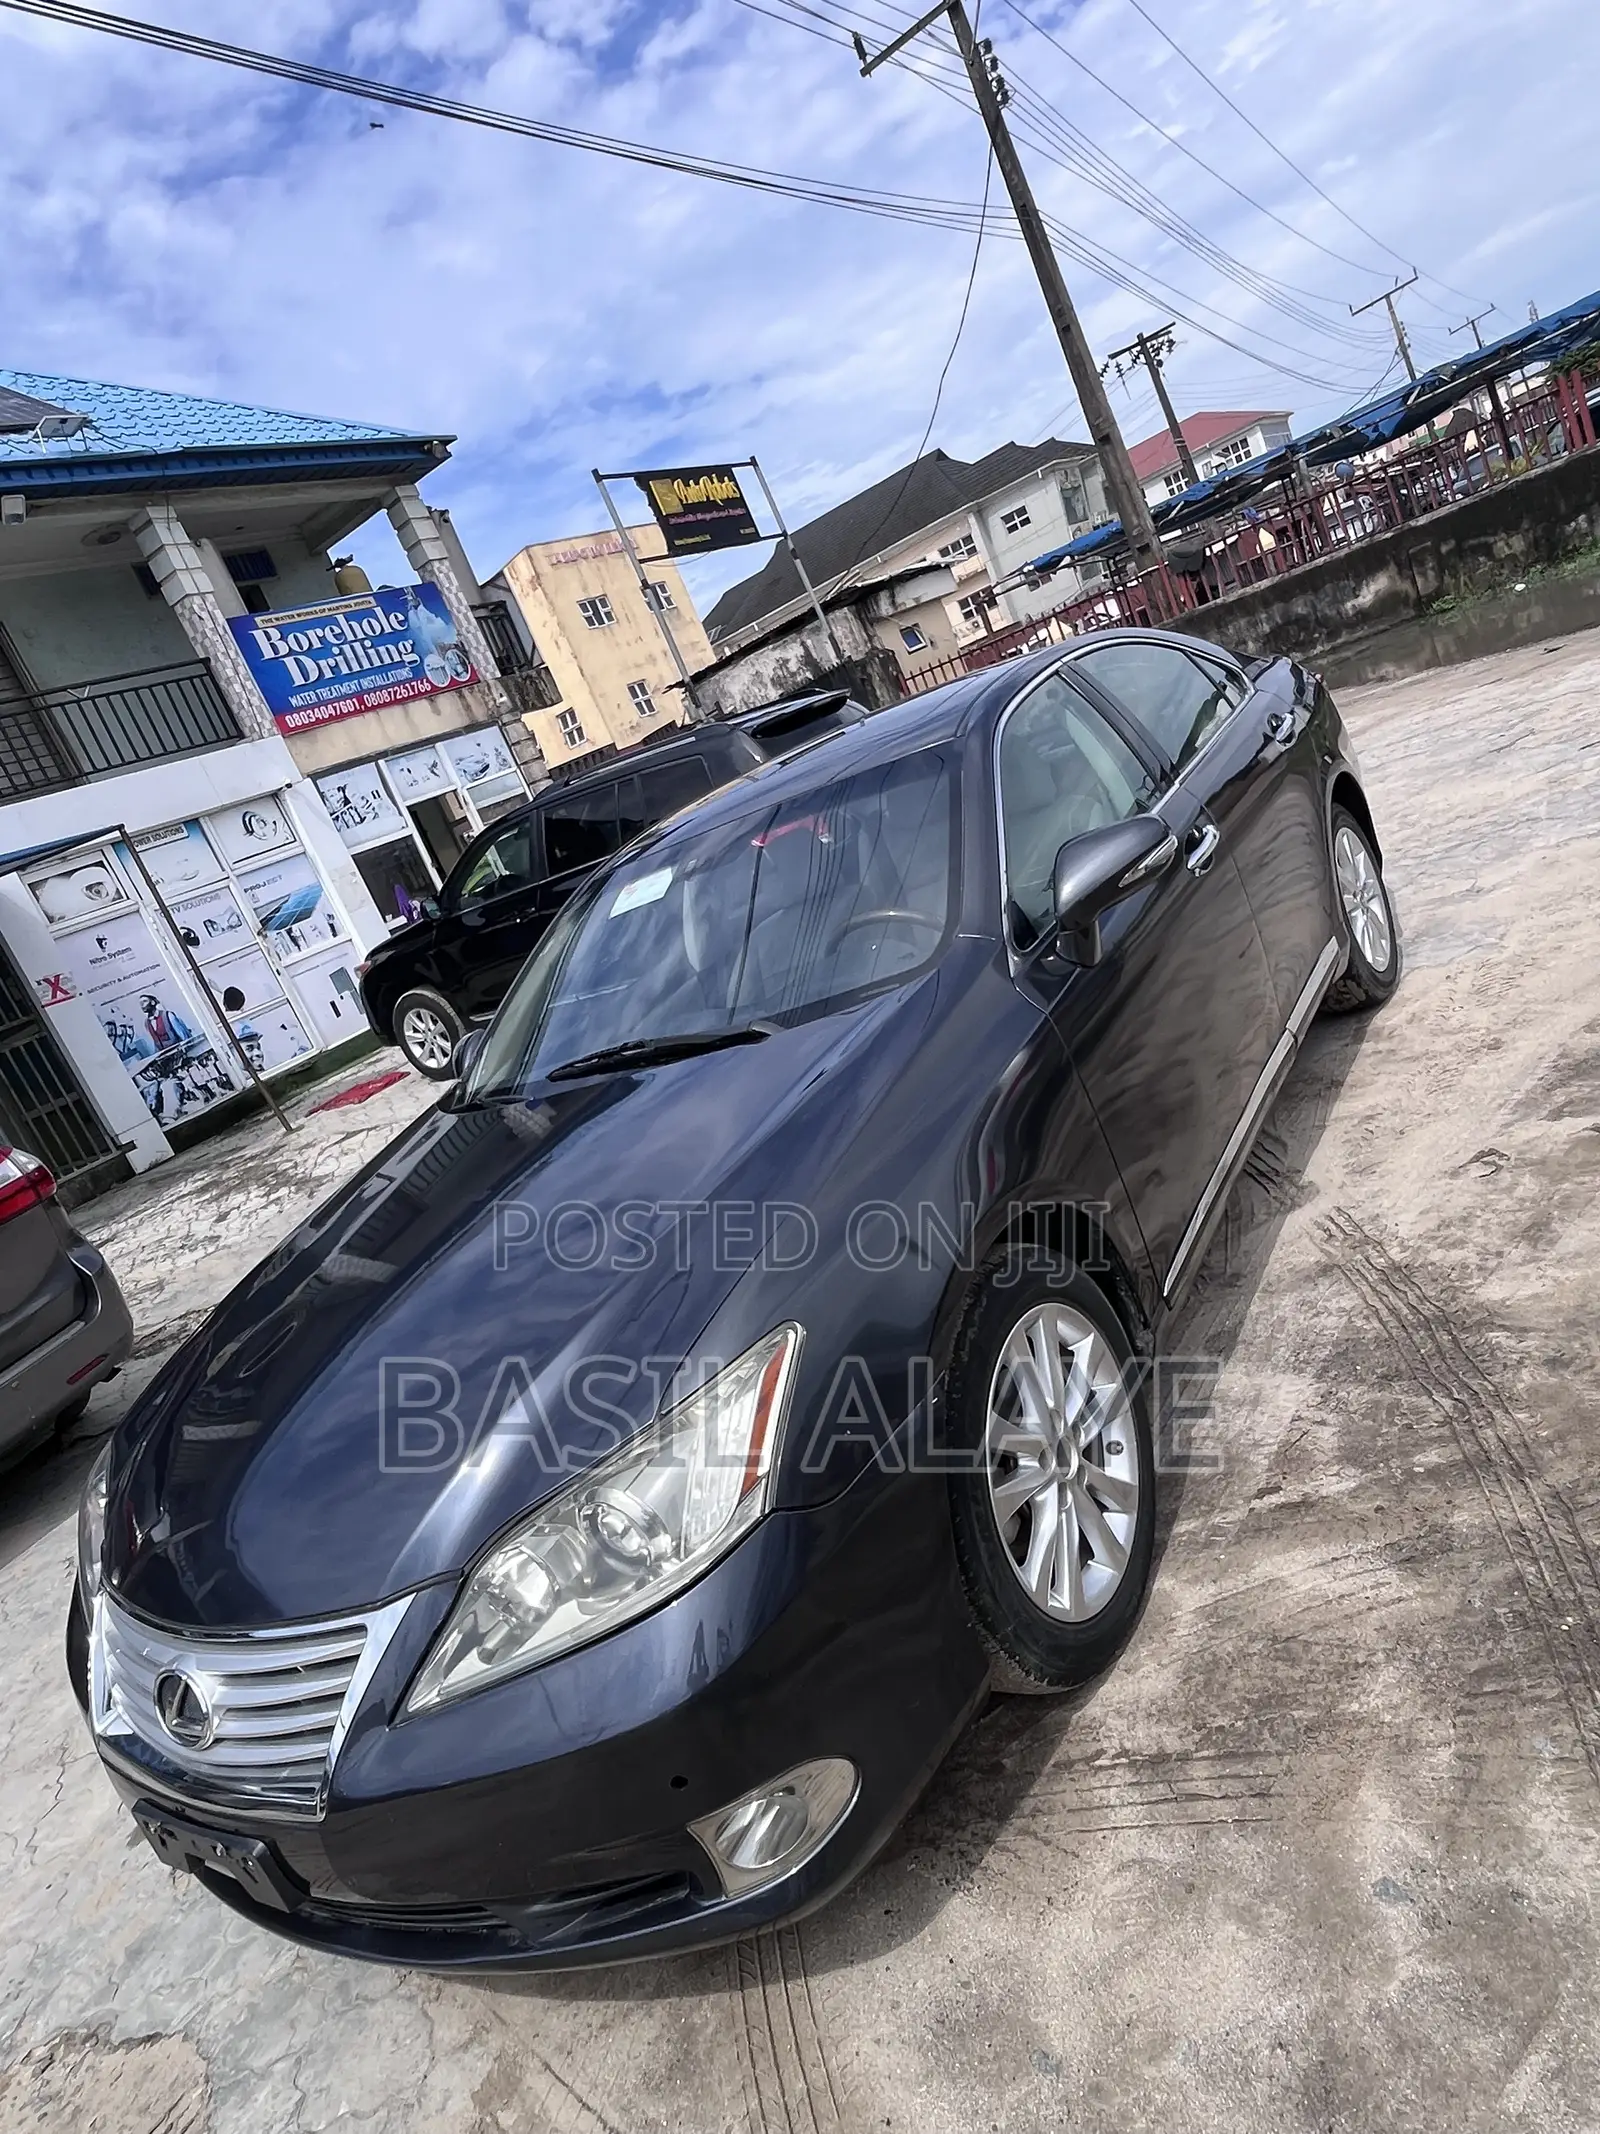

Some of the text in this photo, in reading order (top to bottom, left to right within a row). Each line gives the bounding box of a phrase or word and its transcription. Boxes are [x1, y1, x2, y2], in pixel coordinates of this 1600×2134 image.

[260, 617, 274, 625] THE
[274, 614, 296, 622] WATER
[296, 609, 319, 619] WORKS
[248, 607, 408, 661] Borehole
[280, 638, 421, 688] Drilling
[288, 667, 414, 708] WATER TREATMENT INSTALLATIONS
[363, 679, 432, 709] 08087261766
[132, 826, 184, 848] OWER SOLUTIONS
[243, 874, 283, 894] PROJECT
[181, 892, 222, 911] SOLUTIONS
[89, 953, 107, 966] Nitro
[107, 946, 132, 960] System
[87, 979, 117, 994] SECURITY
[122, 963, 161, 982] AUTOMATION
